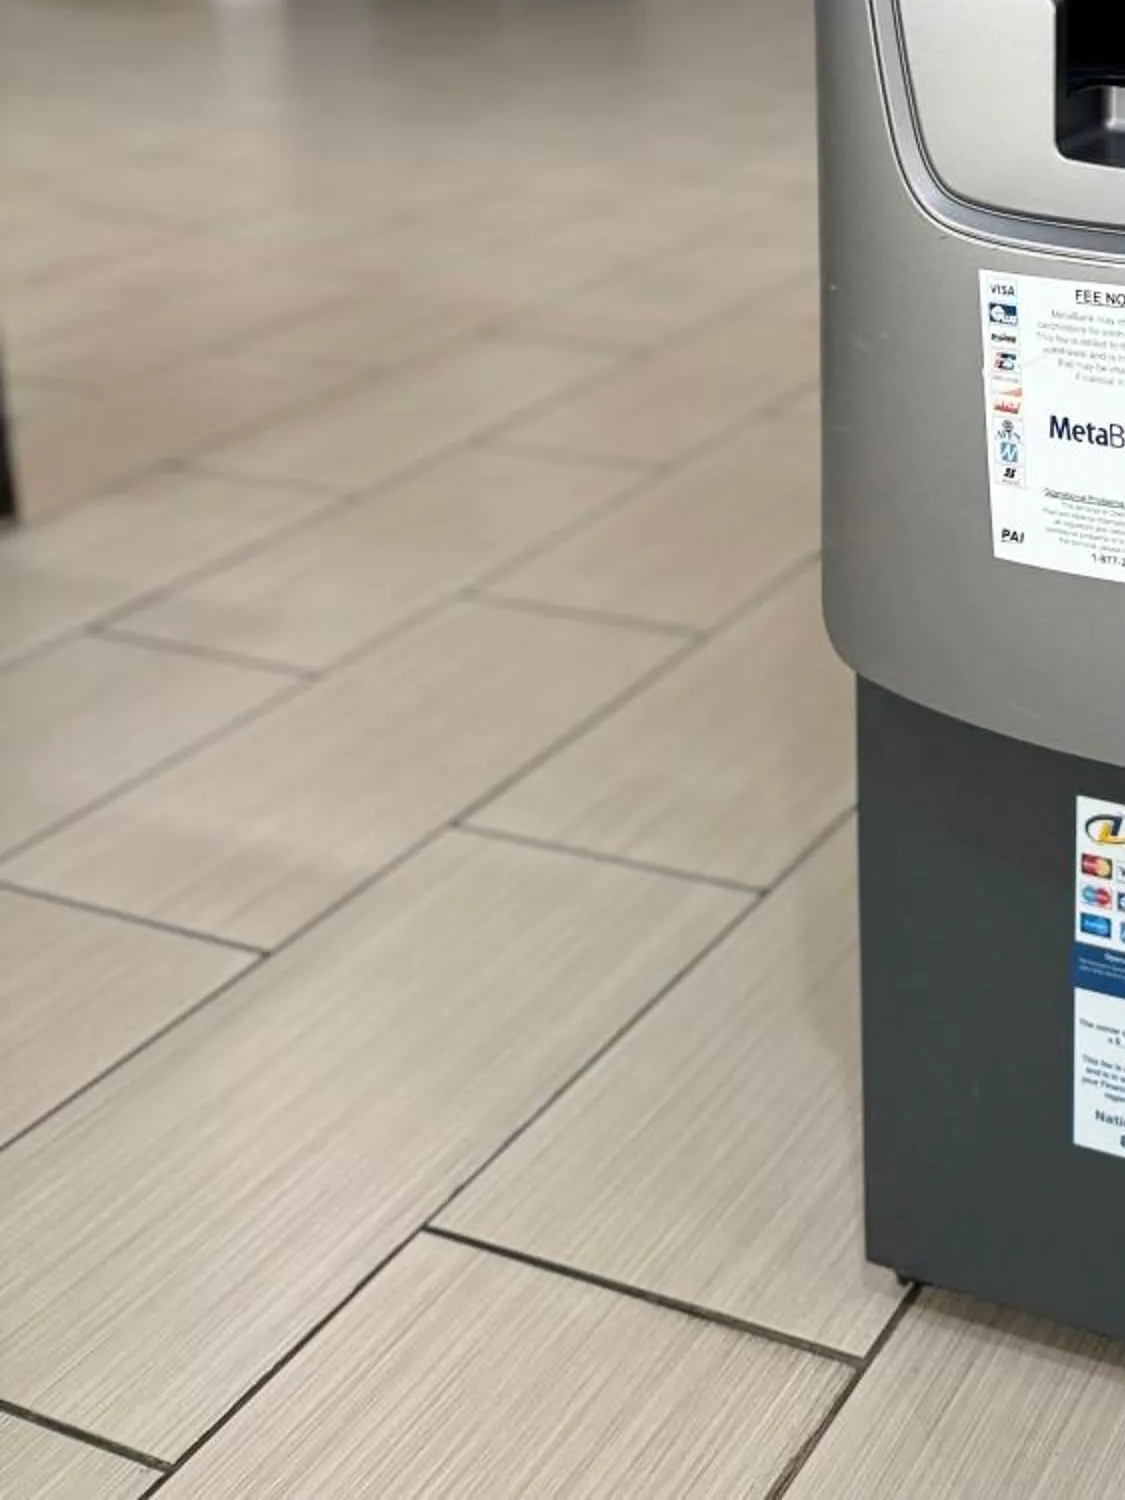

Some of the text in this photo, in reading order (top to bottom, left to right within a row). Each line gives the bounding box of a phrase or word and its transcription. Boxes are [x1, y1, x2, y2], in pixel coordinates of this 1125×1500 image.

[990, 283, 1015, 296] VISA
[1075, 289, 1102, 303] FEE
[1001, 529, 1025, 544] PAI
